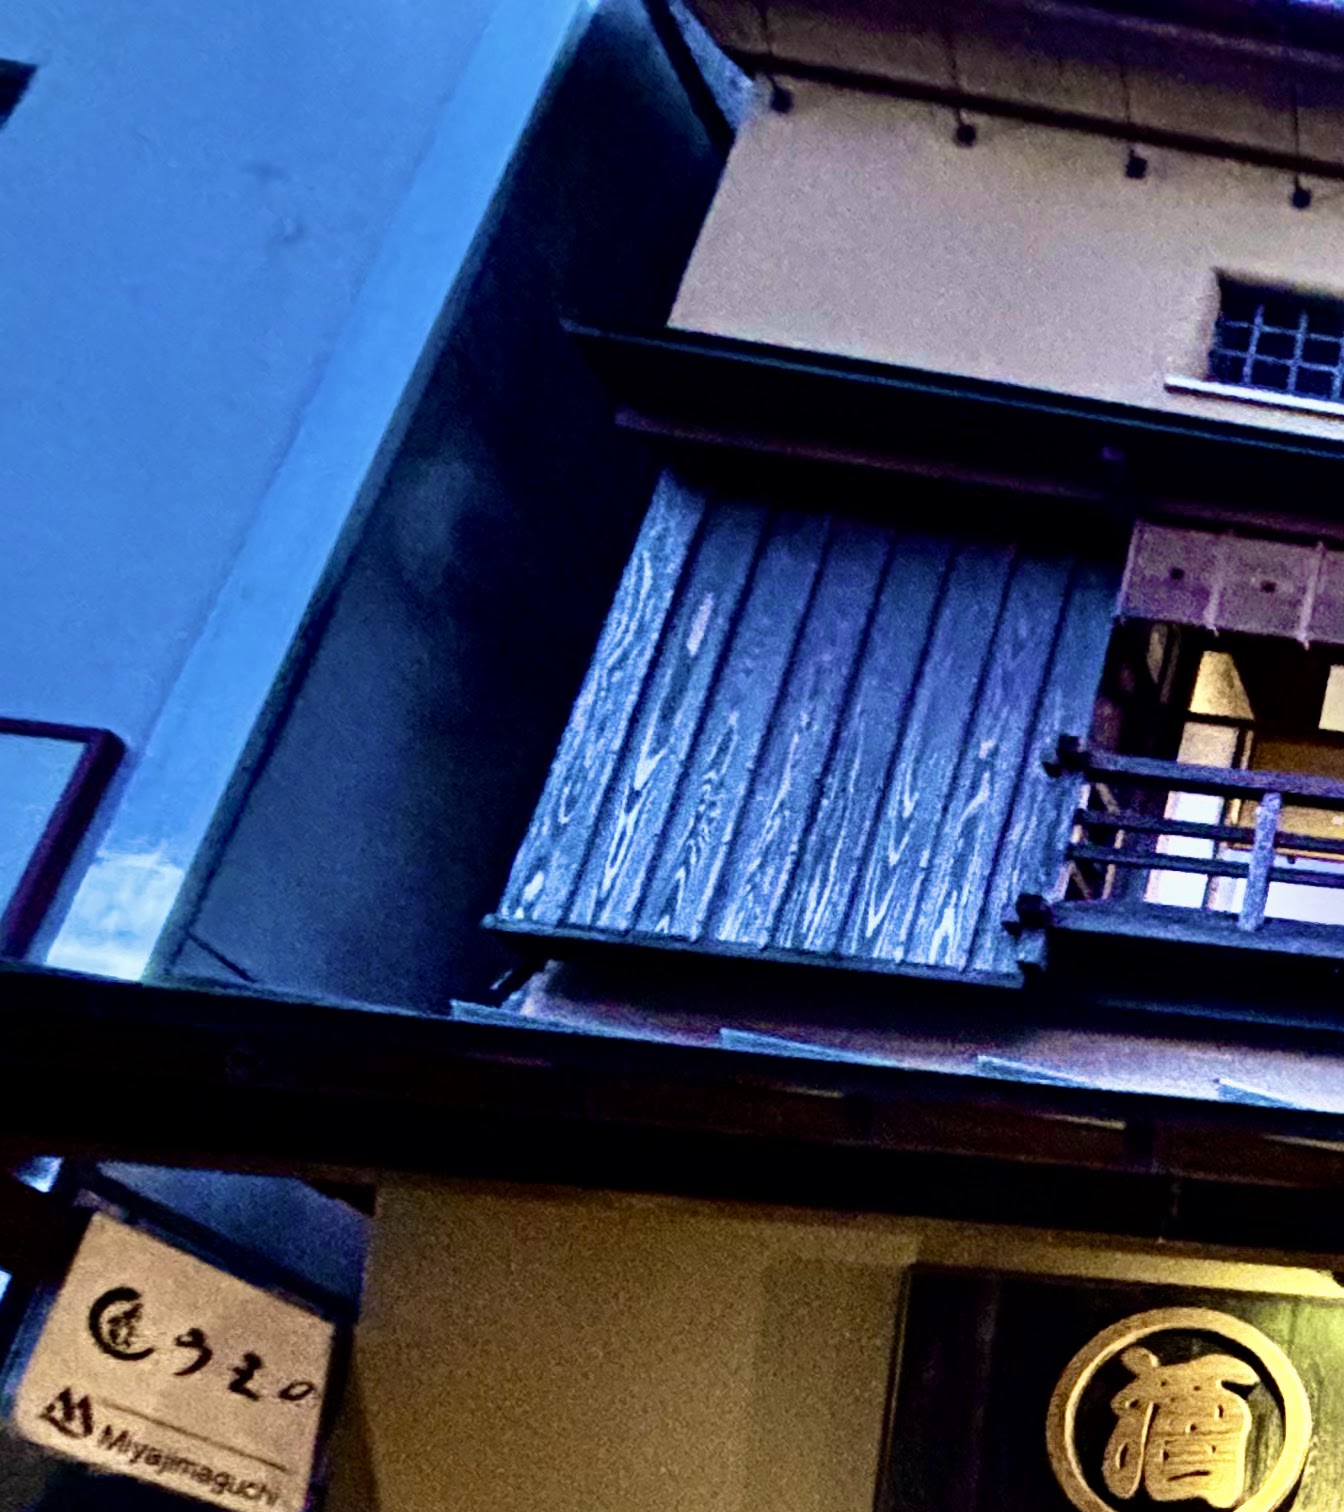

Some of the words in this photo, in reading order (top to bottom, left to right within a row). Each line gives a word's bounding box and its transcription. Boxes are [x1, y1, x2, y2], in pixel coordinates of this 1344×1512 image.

[172, 1326, 317, 1402] うえの
[99, 1424, 283, 1508] Miyajimaguchi
